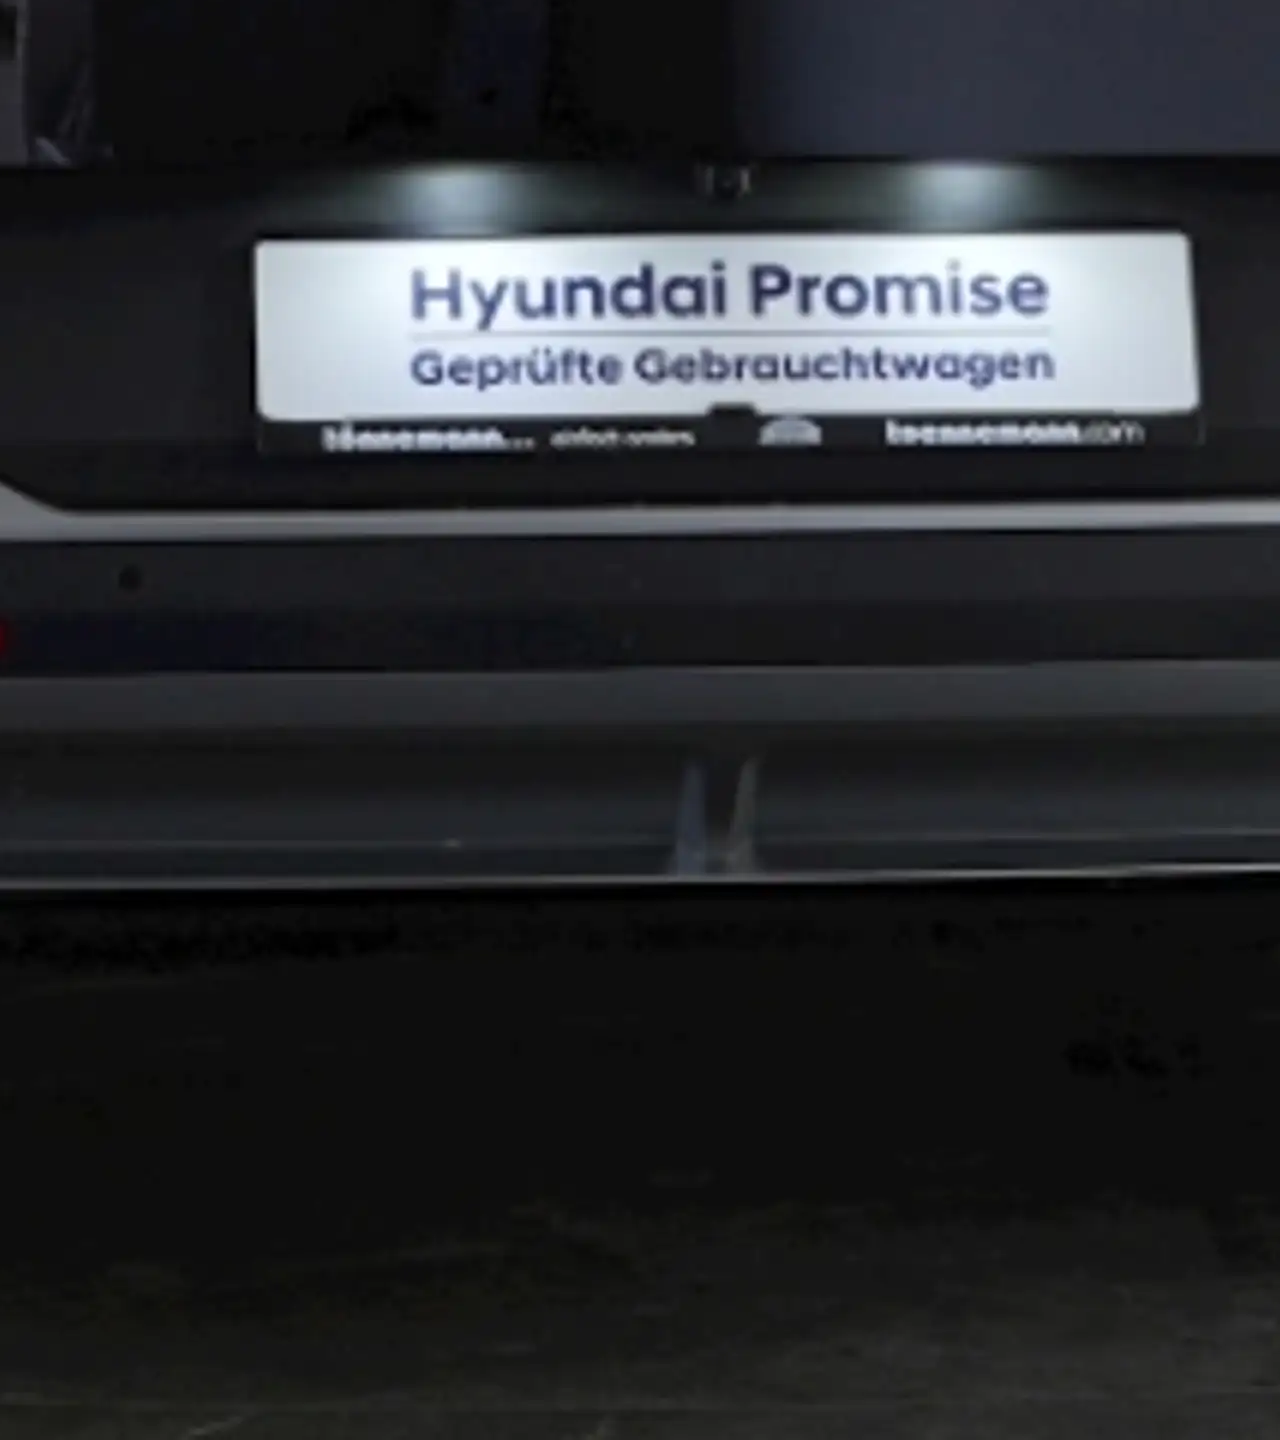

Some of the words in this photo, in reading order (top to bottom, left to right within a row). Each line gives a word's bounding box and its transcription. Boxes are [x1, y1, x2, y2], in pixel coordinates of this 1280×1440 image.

[411, 260, 727, 331] Hyundai
[750, 259, 1050, 318] Promise
[411, 346, 624, 392] Geprüfte
[633, 346, 1056, 390] Gebrauchtwagen
